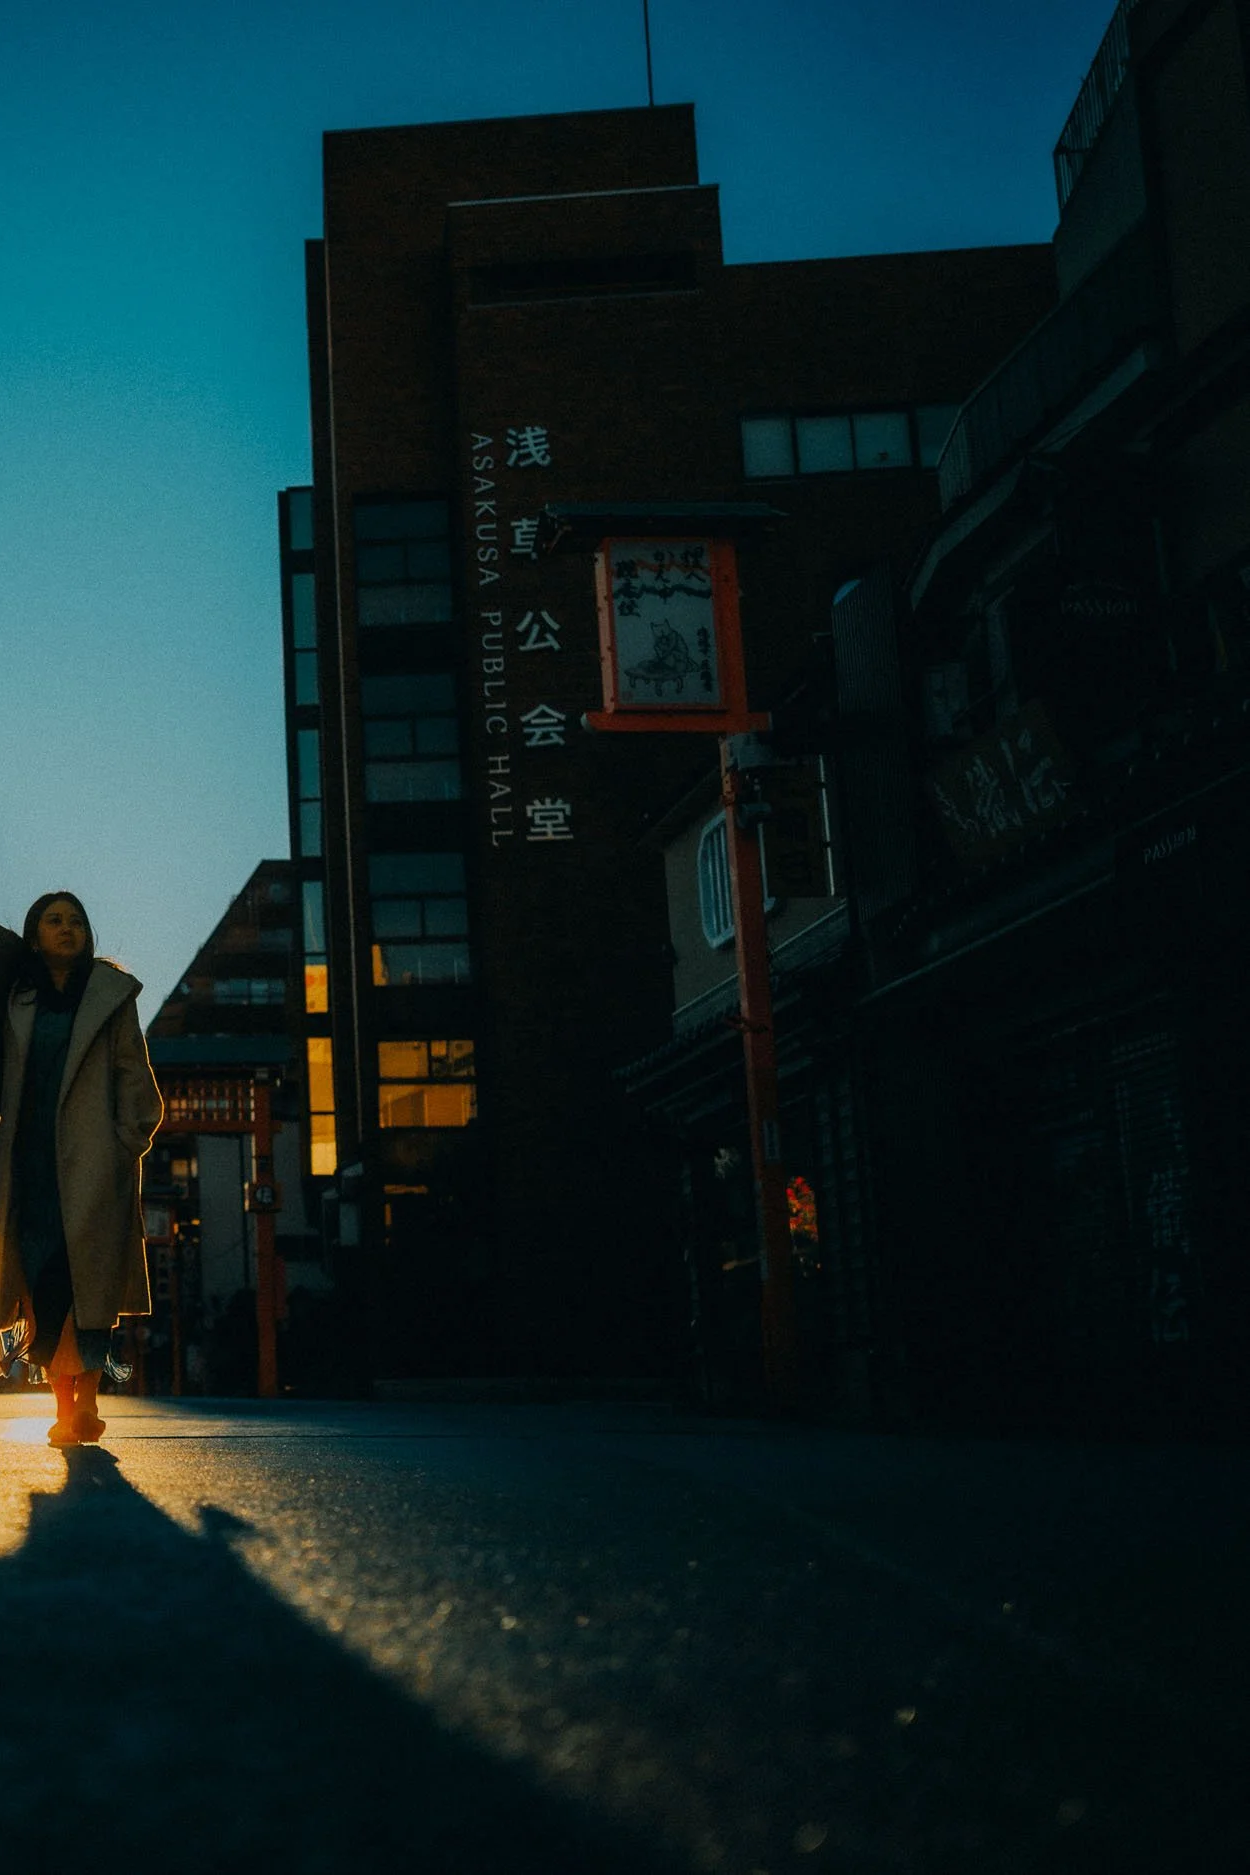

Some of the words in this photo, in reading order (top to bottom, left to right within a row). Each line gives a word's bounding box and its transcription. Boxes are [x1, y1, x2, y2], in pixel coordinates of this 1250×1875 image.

[470, 432, 500, 587] ASAKUSA
[479, 609, 508, 737] PUBLIC
[505, 424, 575, 843] 浅草公会堂
[487, 755, 514, 848] HALL
[1143, 824, 1197, 865] PASSION
